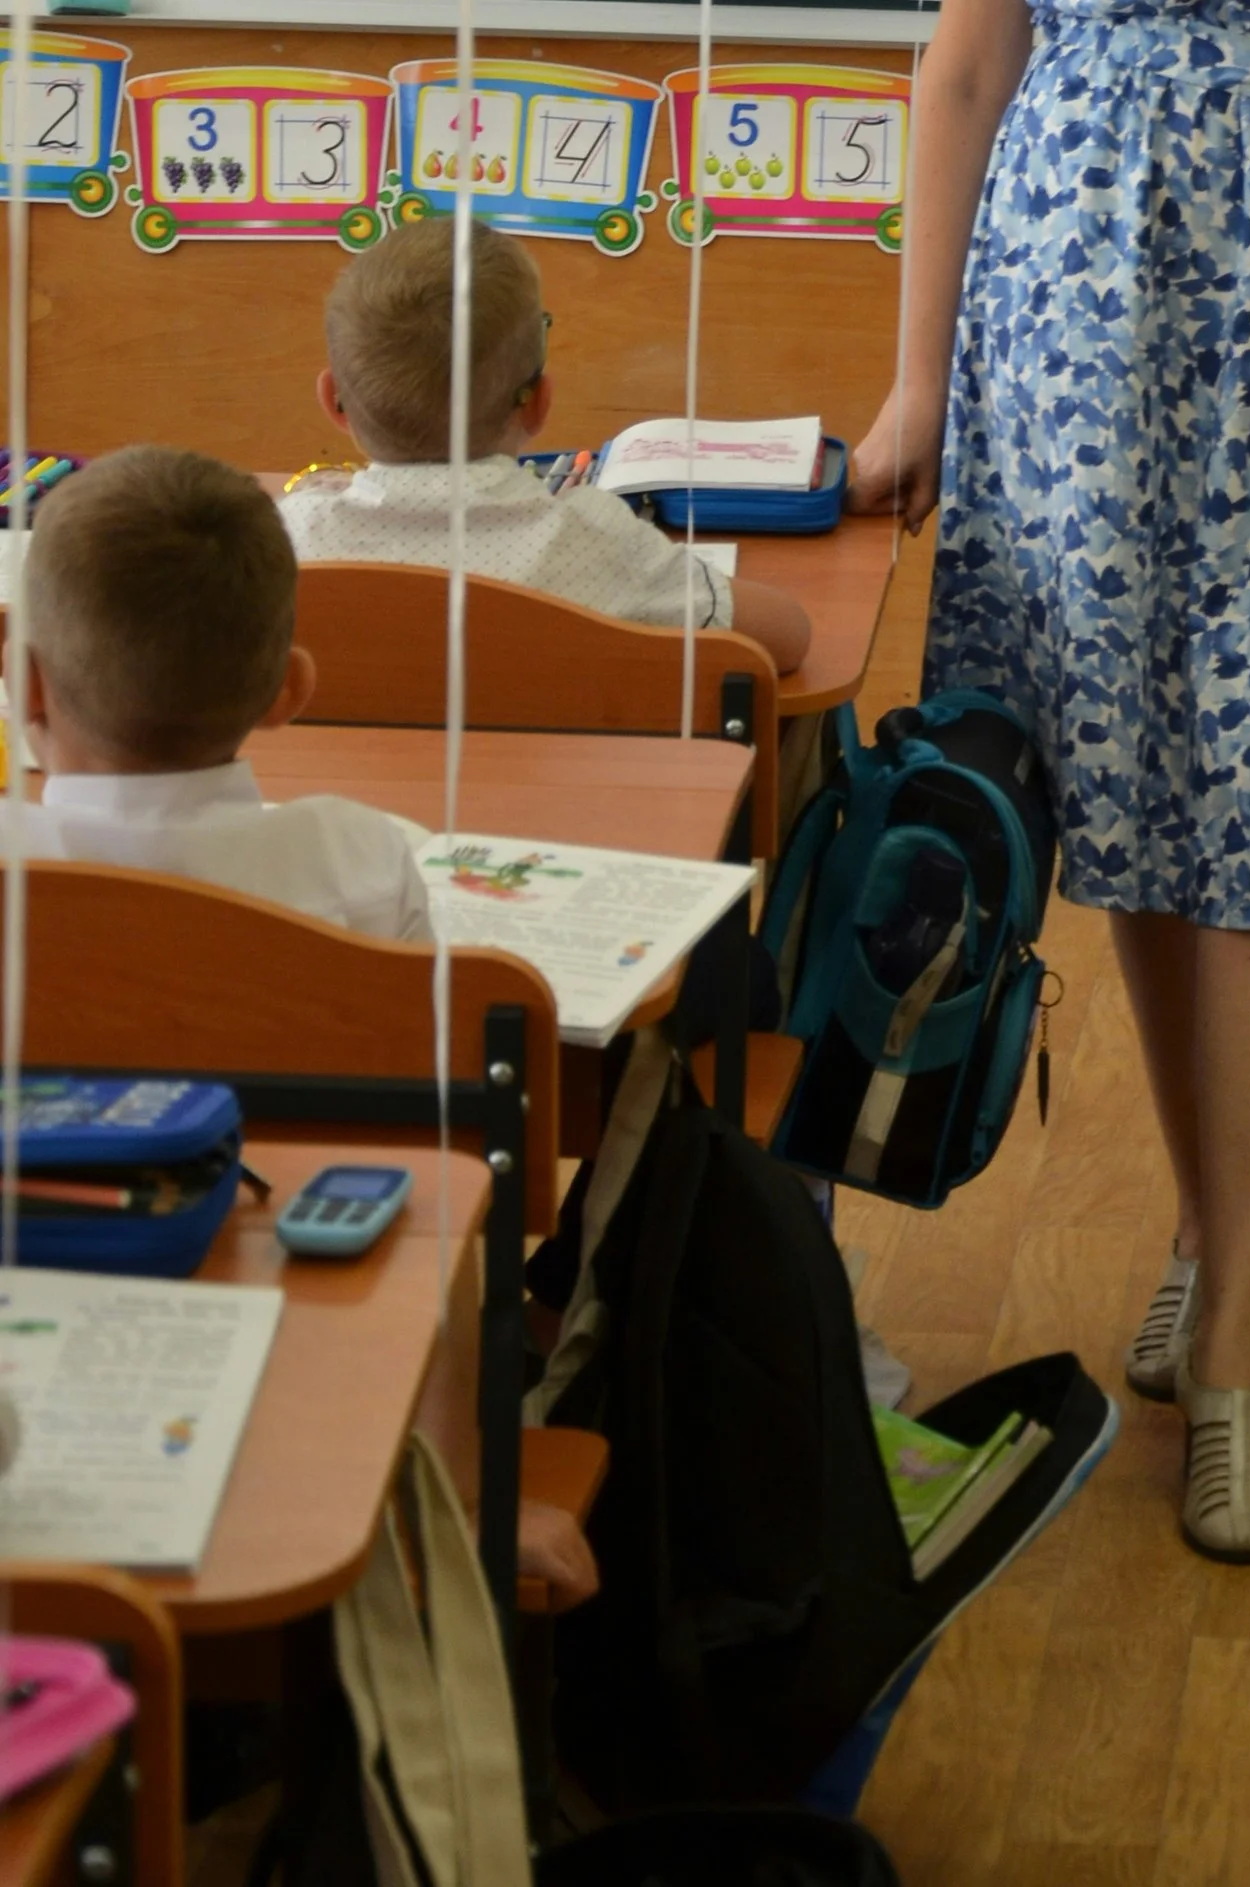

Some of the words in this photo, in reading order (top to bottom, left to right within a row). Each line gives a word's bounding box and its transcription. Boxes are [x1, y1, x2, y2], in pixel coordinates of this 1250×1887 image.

[38, 83, 80, 149] 2
[187, 106, 218, 152] 3
[300, 120, 346, 185] 3
[450, 97, 484, 141] 4
[555, 119, 611, 184] 4
[728, 103, 759, 146] 5
[834, 115, 888, 184] 5
